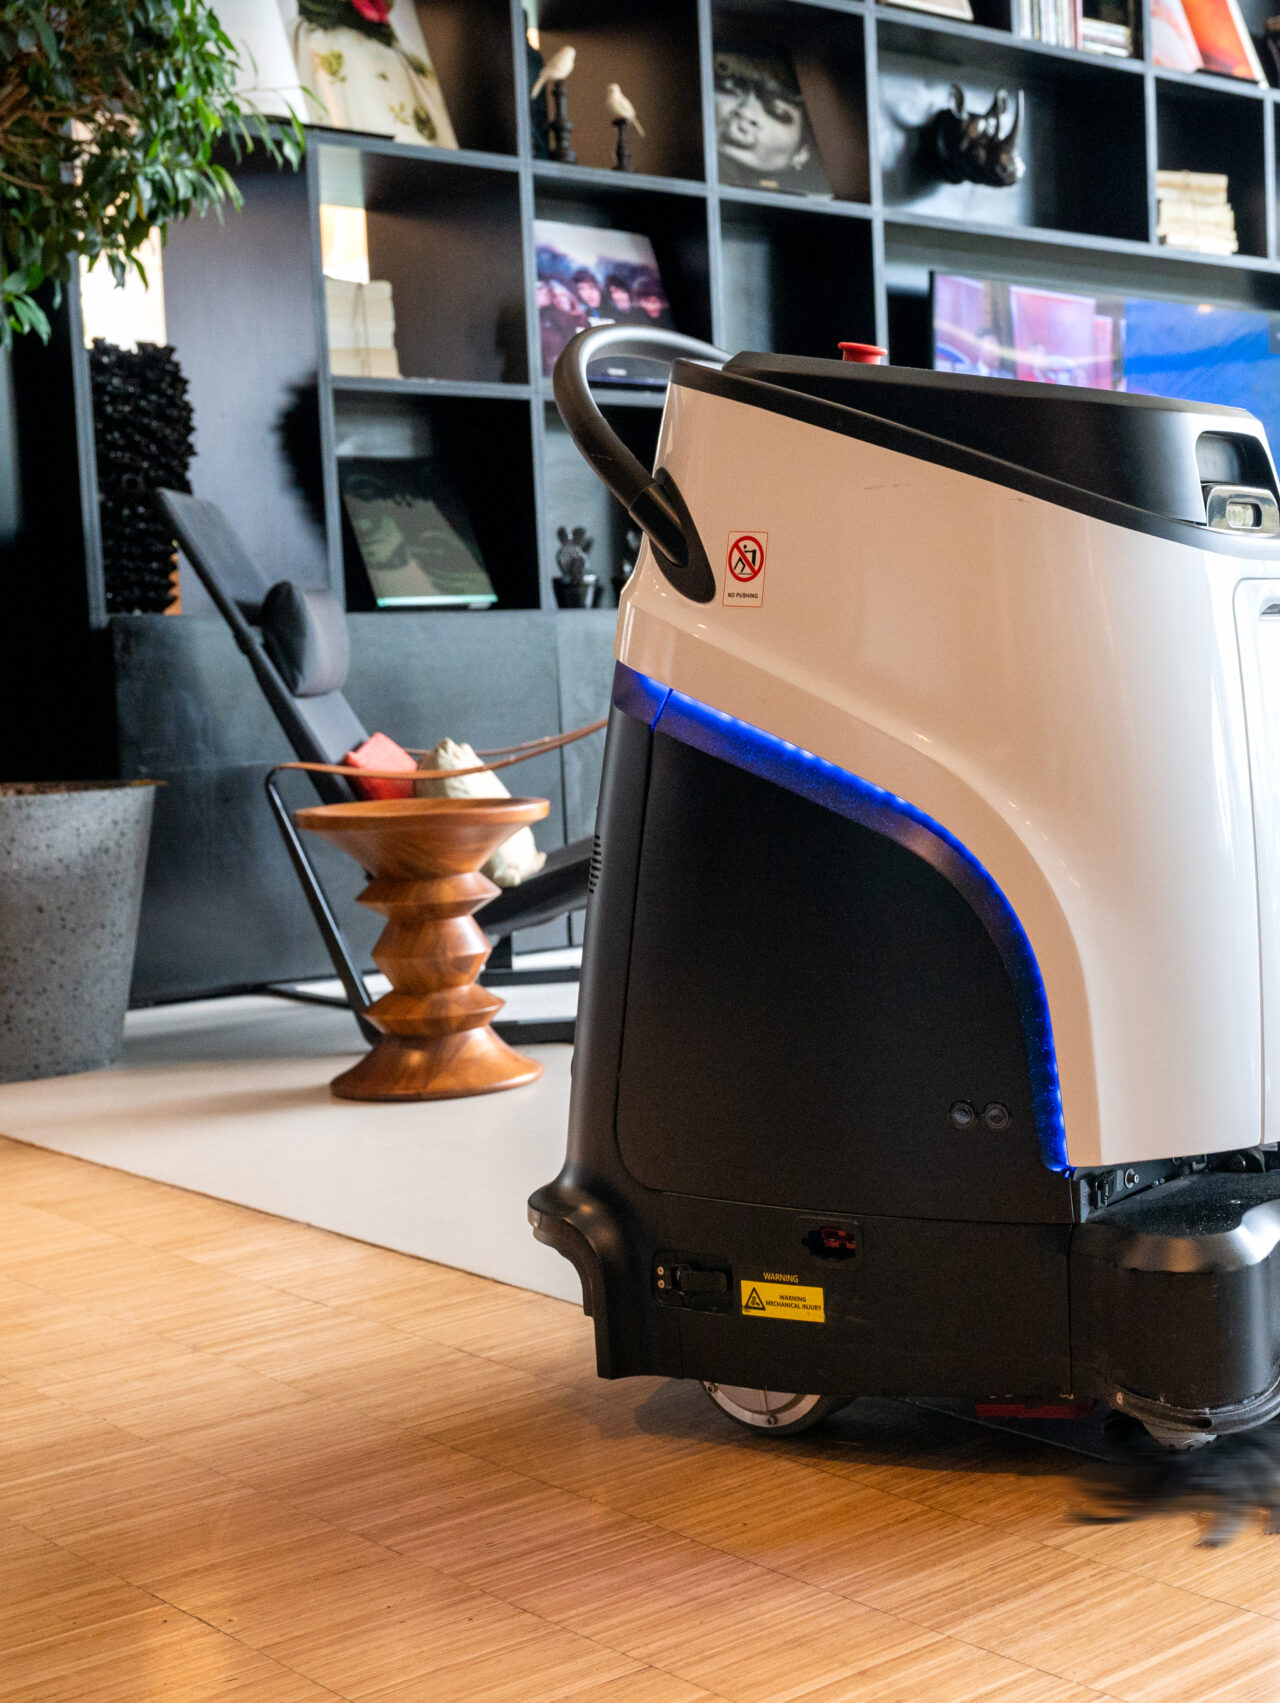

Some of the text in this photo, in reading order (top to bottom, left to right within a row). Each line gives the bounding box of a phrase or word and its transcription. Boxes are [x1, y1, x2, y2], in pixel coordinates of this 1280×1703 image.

[763, 1272, 799, 1283] WARNING
[779, 1294, 807, 1303] WARNING
[765, 1300, 822, 1311] MECHANICAL INJURY
